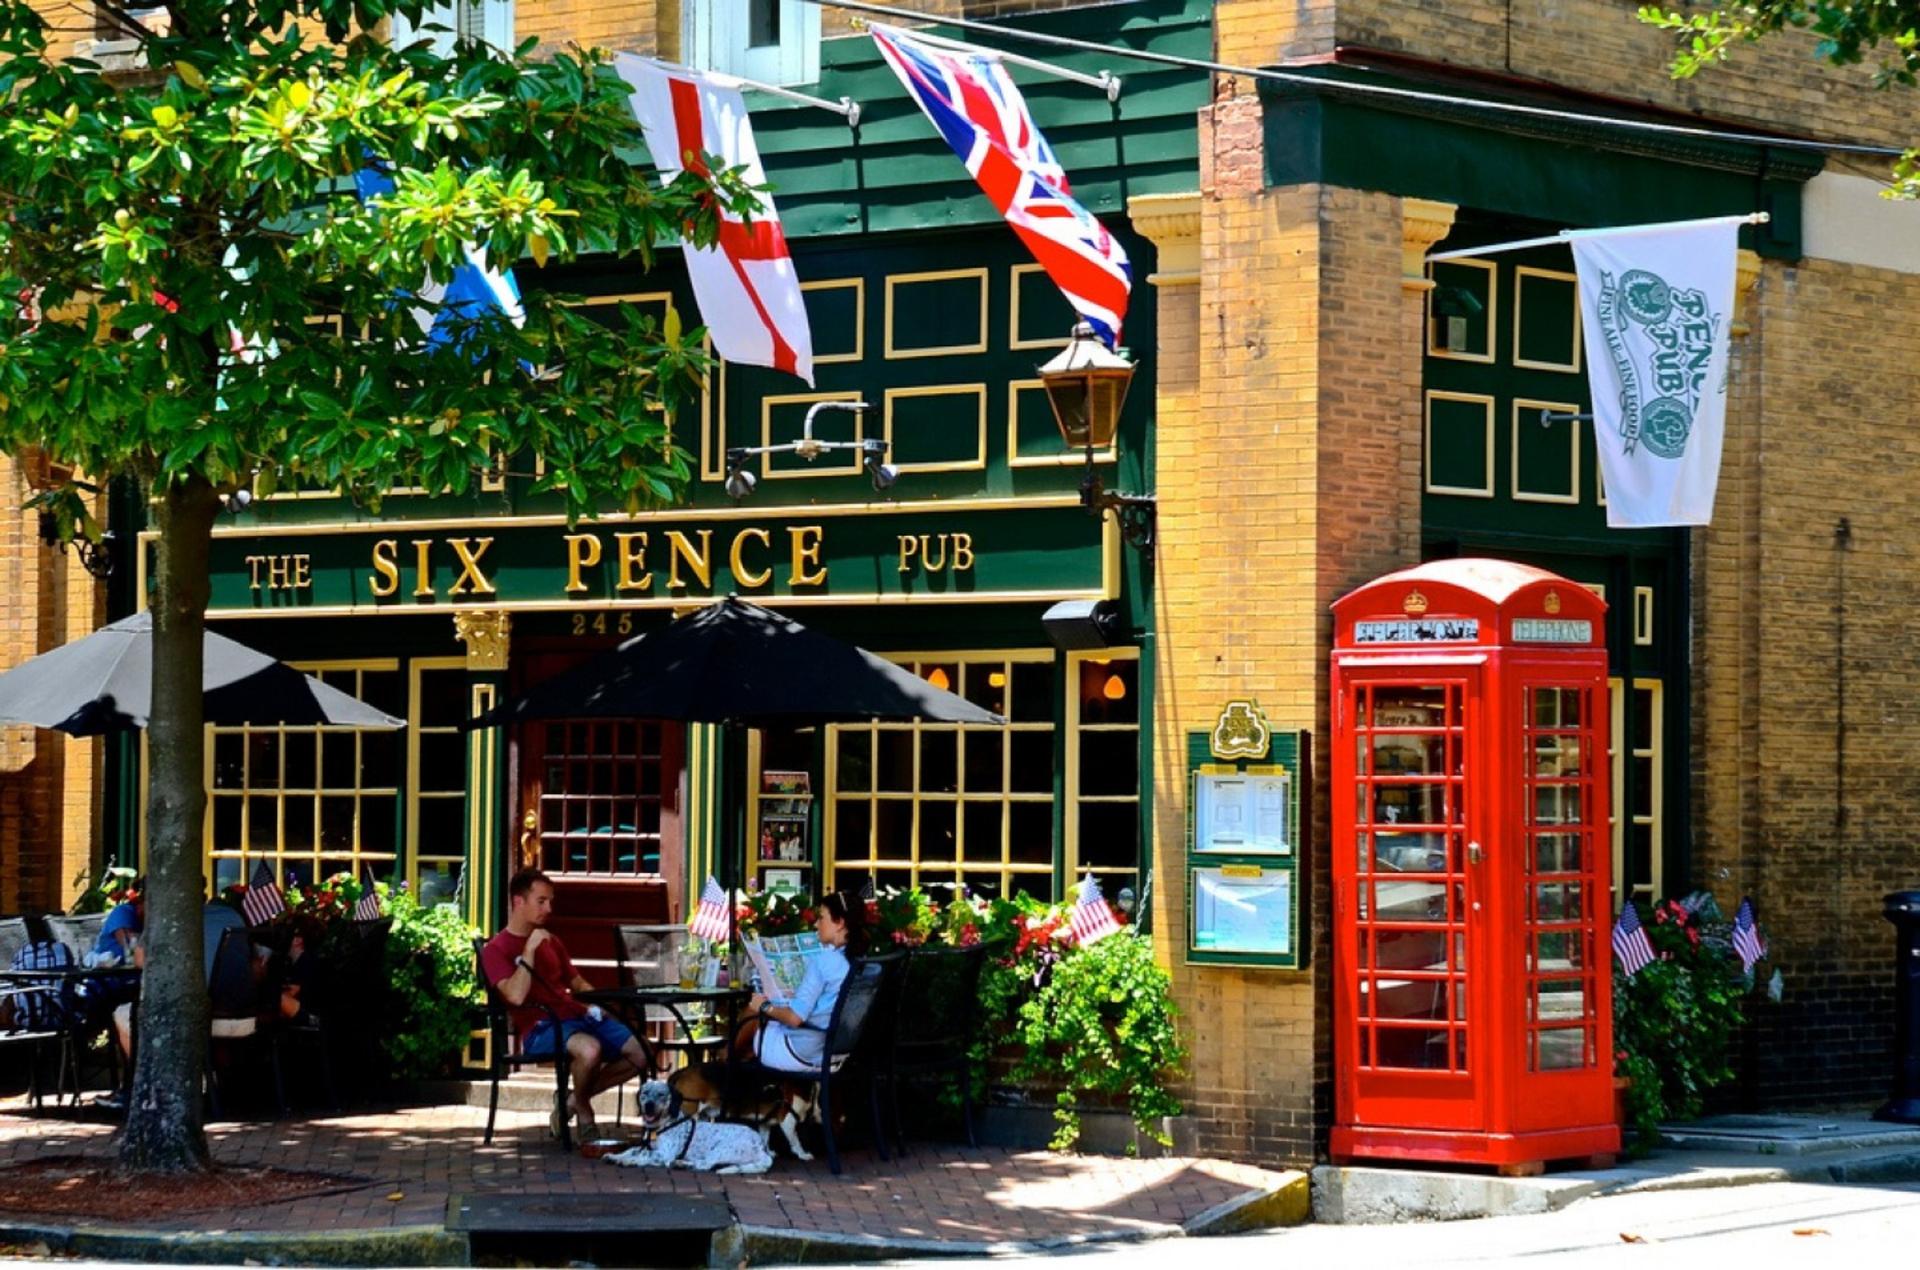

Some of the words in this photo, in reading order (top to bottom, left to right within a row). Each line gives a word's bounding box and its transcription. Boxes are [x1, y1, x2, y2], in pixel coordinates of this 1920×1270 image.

[1649, 326, 1684, 393] PUB
[1627, 394, 1639, 435] FOOD
[245, 554, 312, 589] THE
[369, 537, 496, 596] SIX
[563, 526, 827, 592] PENCE
[897, 533, 974, 571] PUB
[572, 612, 633, 636] 245
[1514, 621, 1588, 641] TELEPHONE
